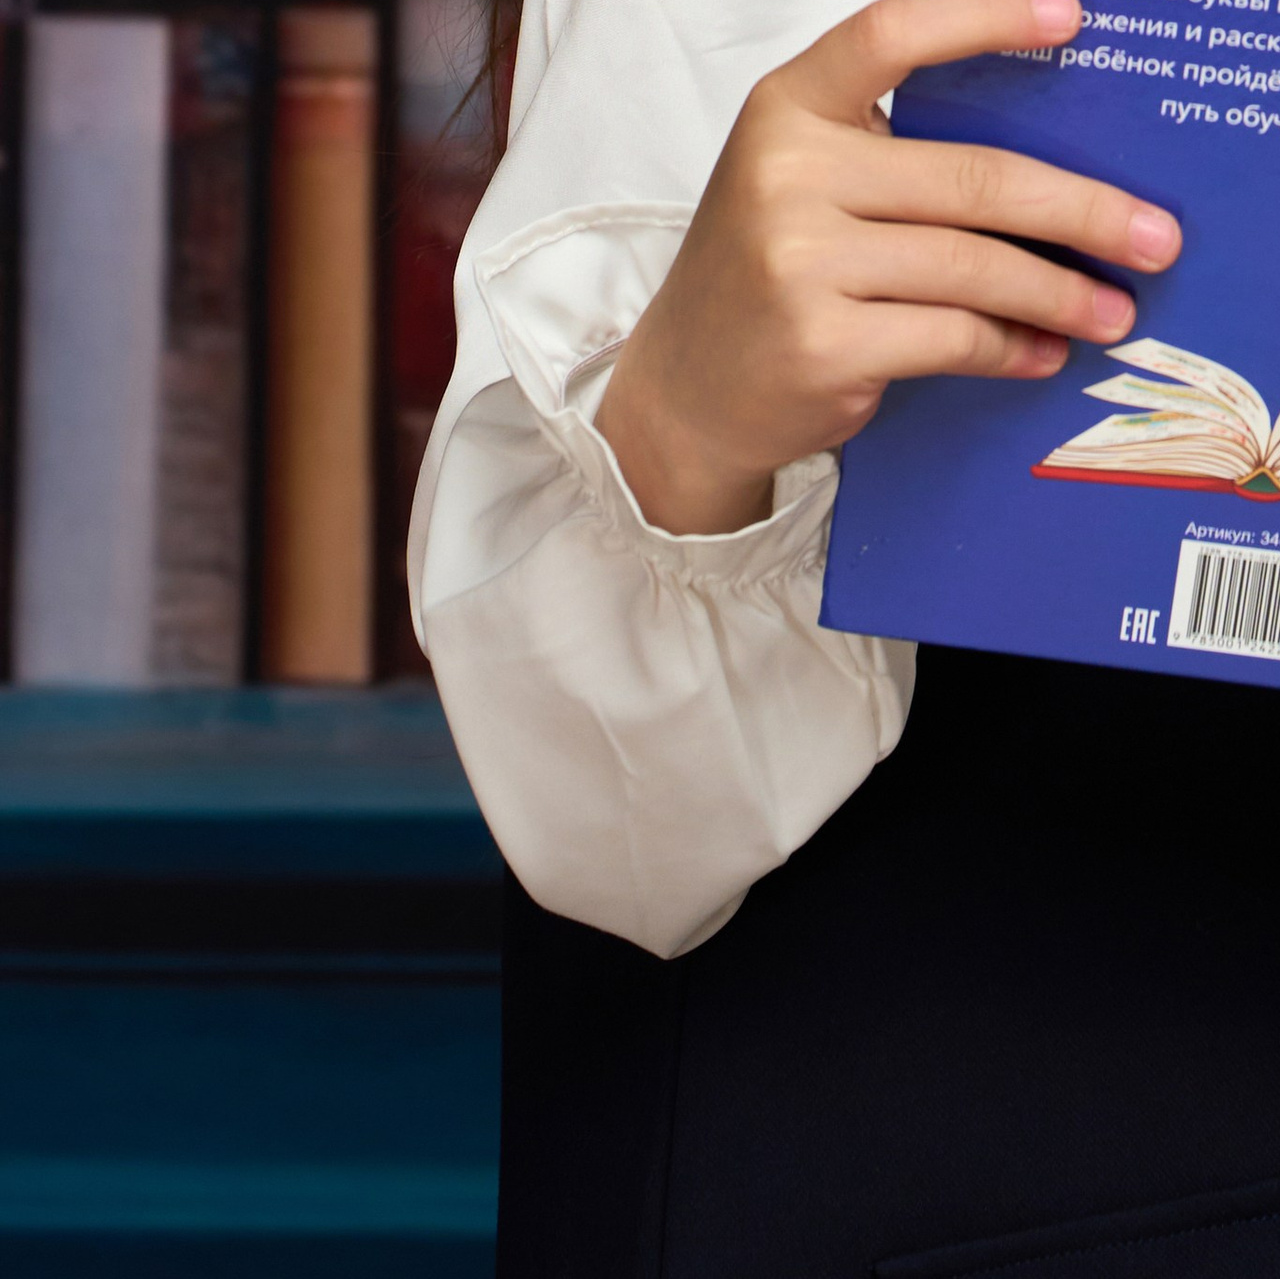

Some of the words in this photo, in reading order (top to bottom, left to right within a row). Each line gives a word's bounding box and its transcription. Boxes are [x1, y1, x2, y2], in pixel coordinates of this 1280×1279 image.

[1082, 10, 1179, 39] ожения
[1184, 24, 1203, 42] и
[1060, 45, 1176, 78] ребёнок
[1160, 99, 1220, 124] путь
[1184, 521, 1256, 544] Артикул:
